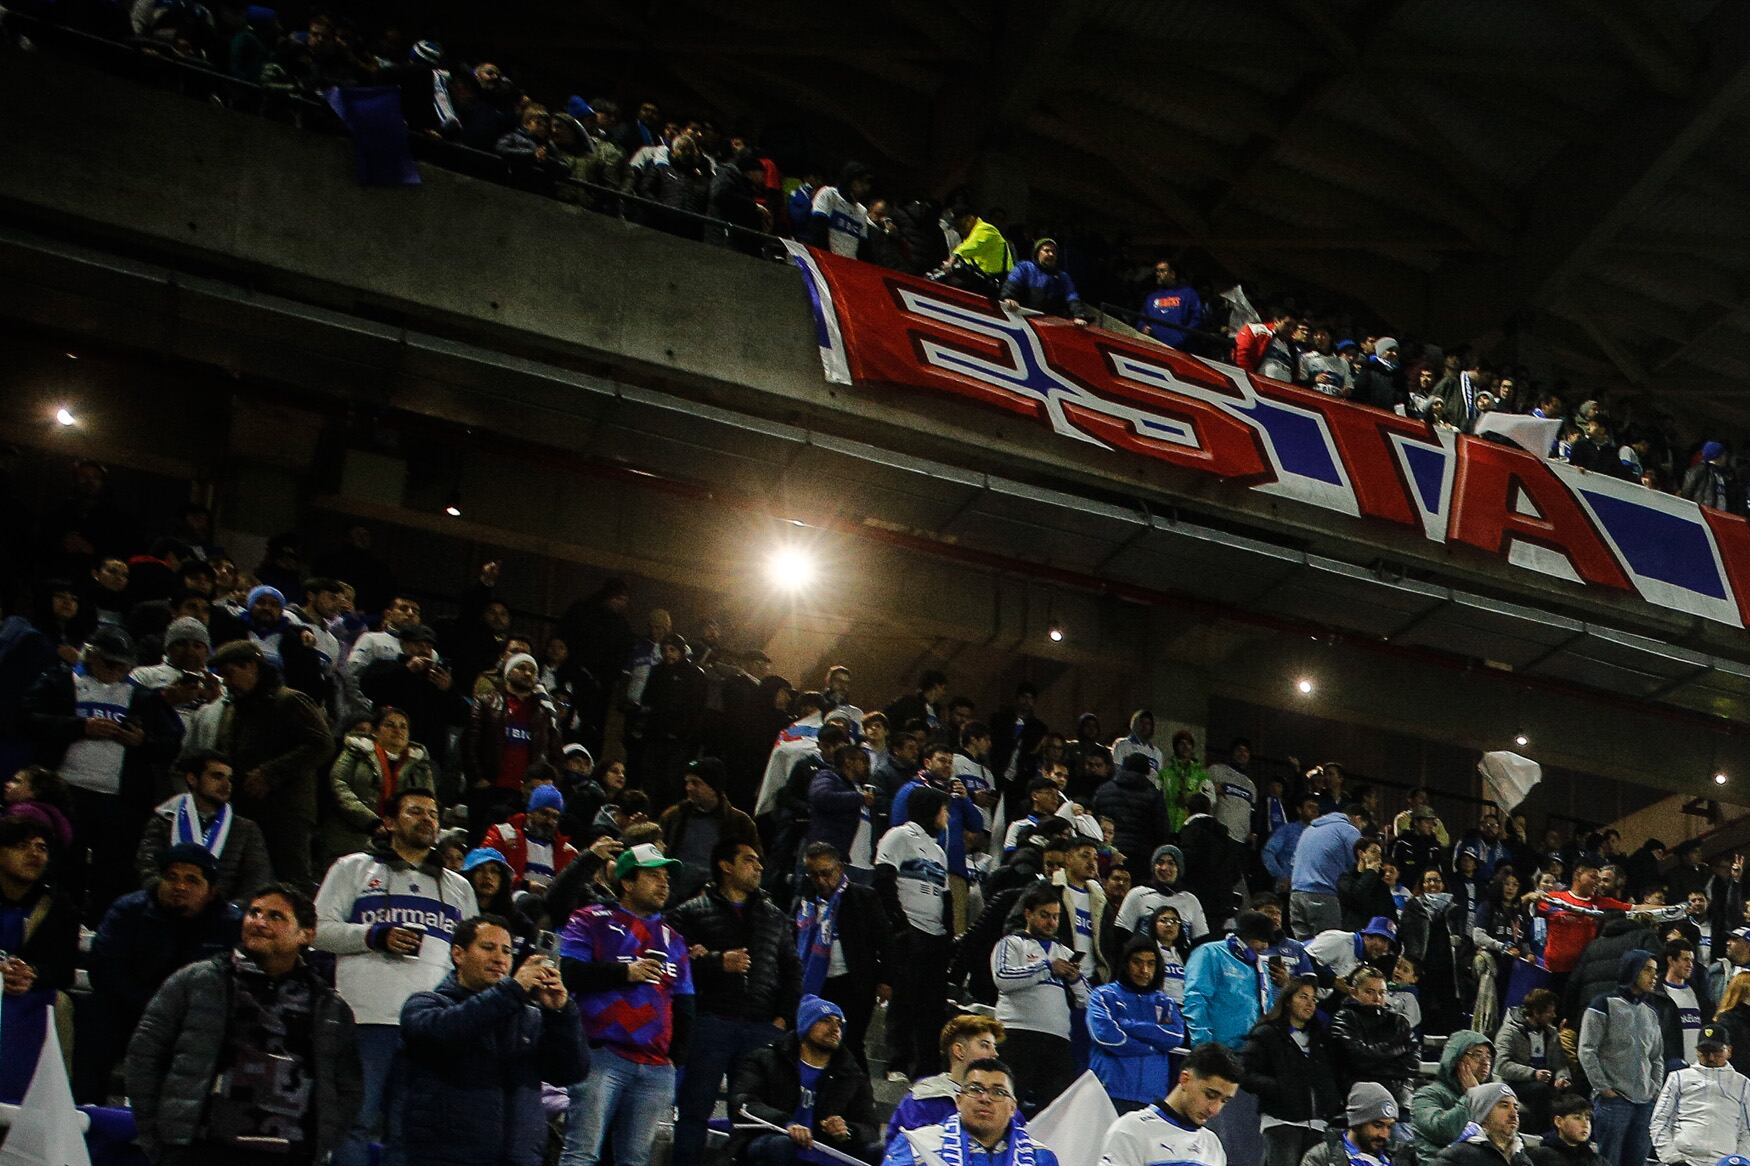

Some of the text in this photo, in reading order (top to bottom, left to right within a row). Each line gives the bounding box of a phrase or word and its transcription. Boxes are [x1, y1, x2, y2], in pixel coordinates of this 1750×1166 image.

[811, 246, 1636, 592] ESTA
[93, 708, 128, 724] BIC
[361, 907, 457, 934] parmala
